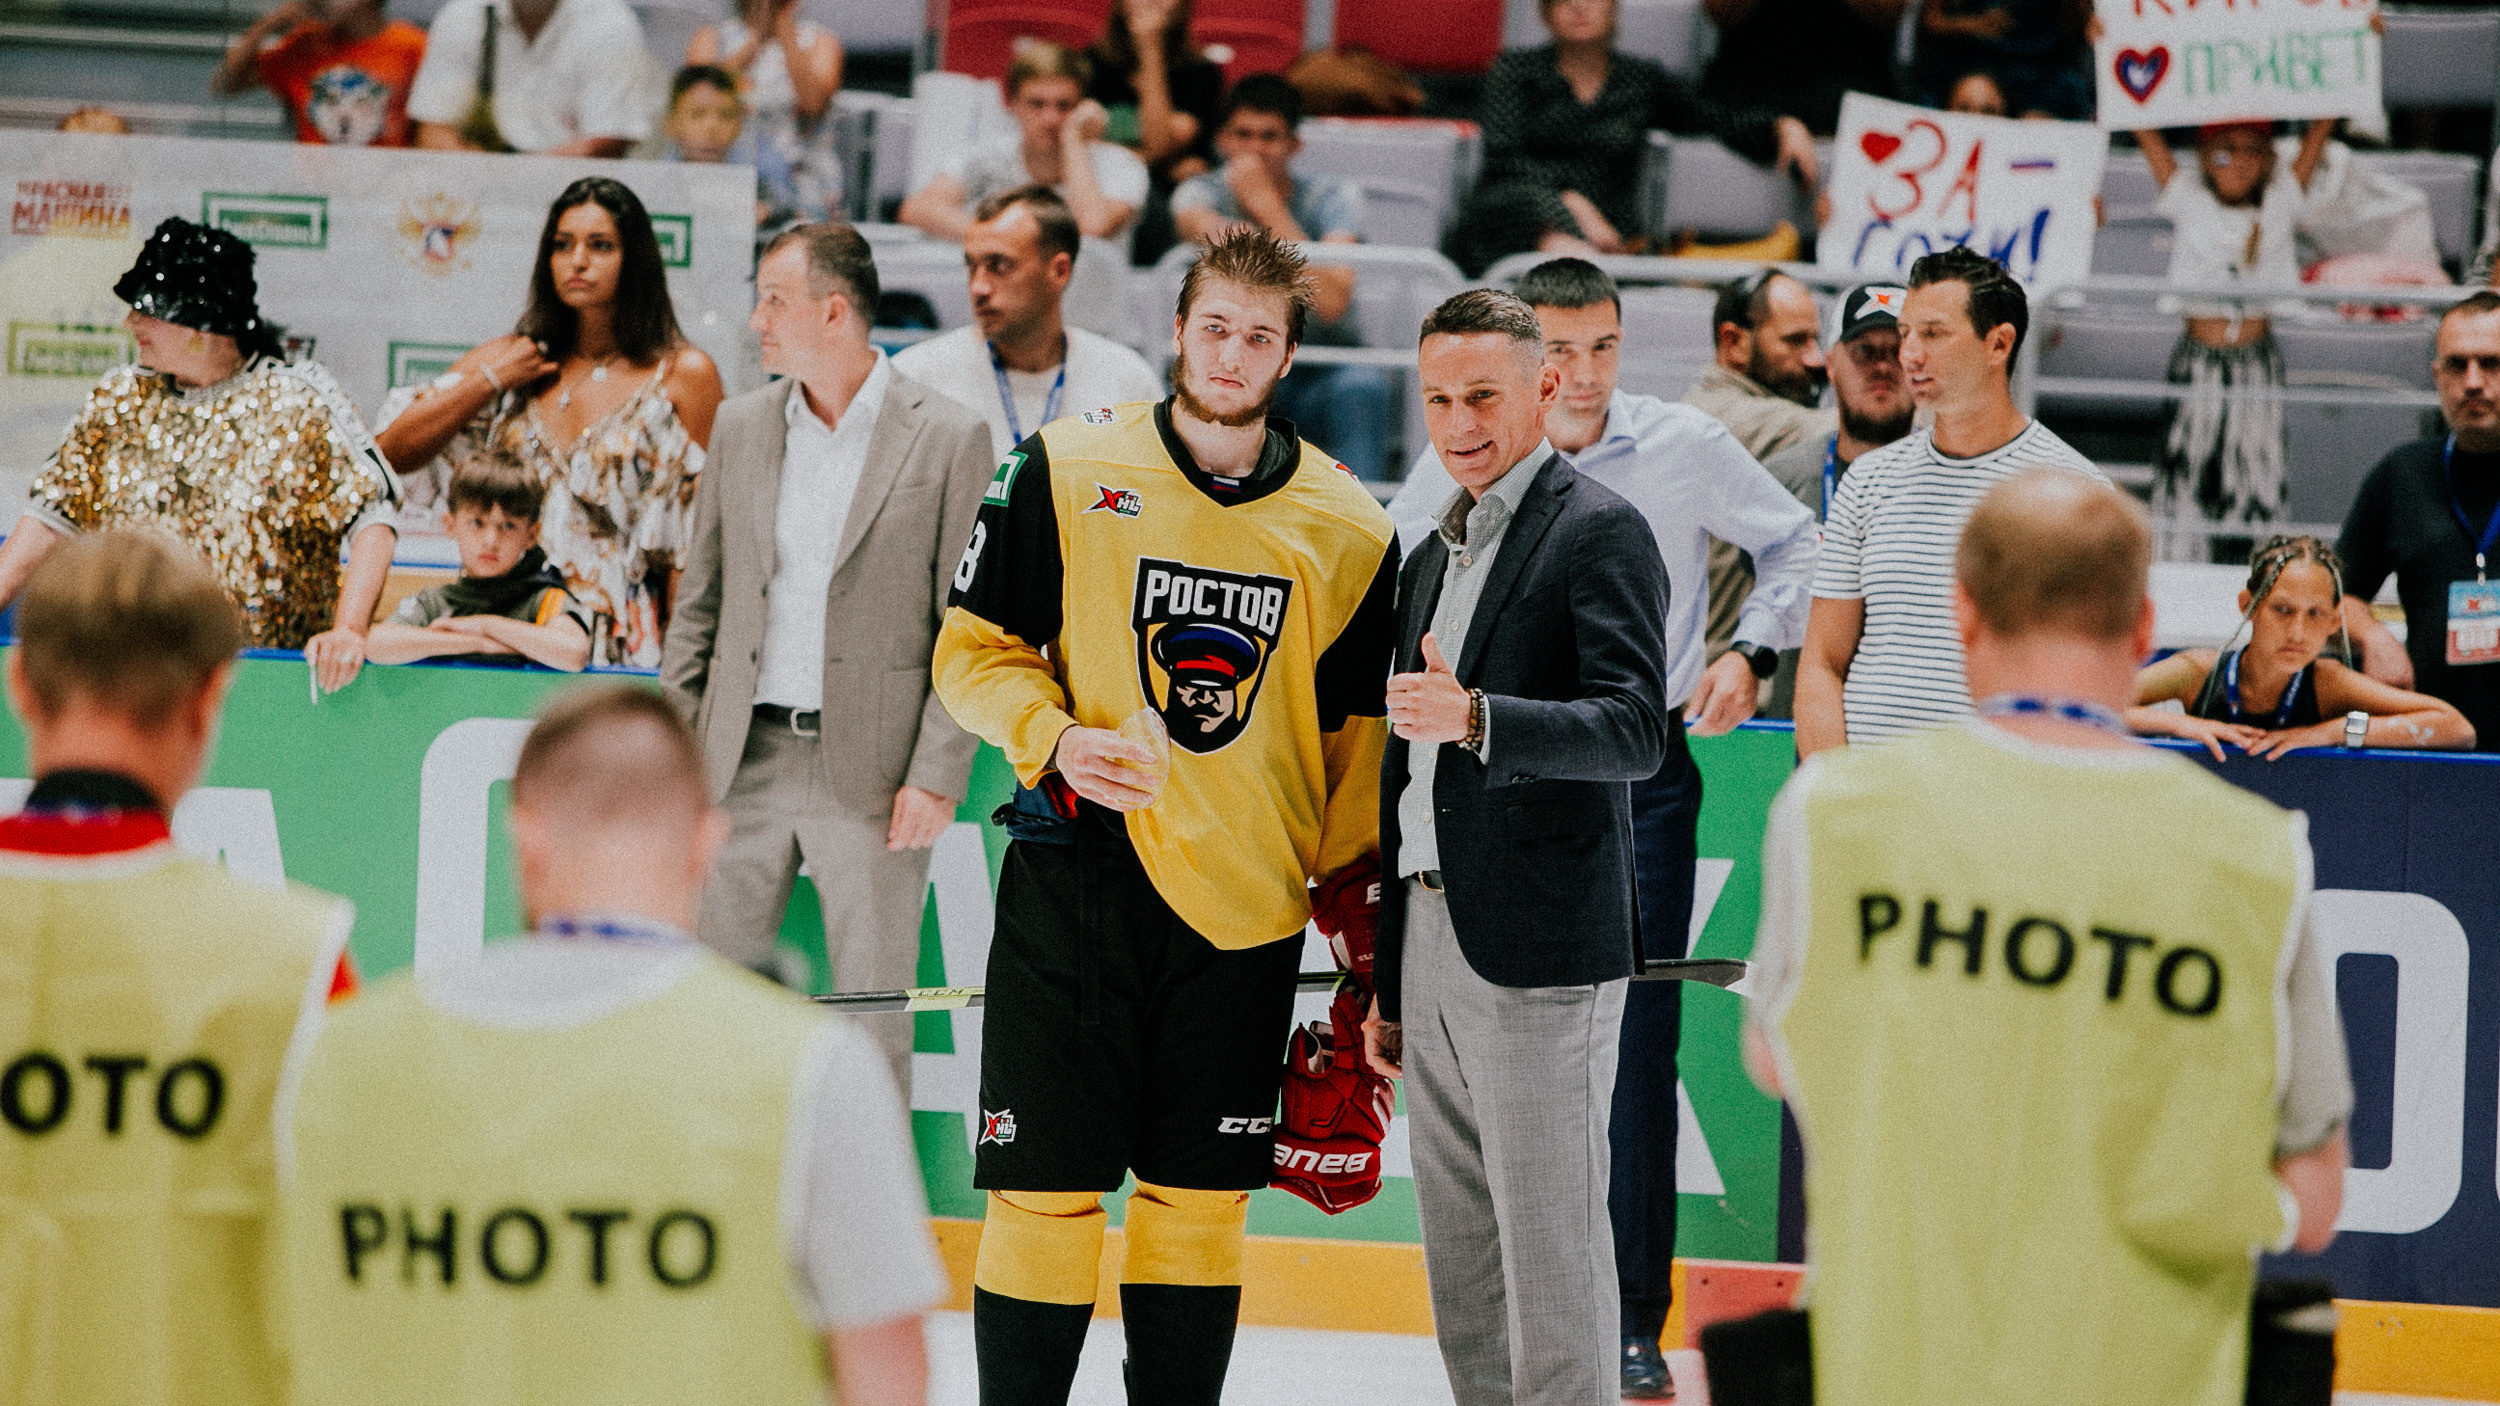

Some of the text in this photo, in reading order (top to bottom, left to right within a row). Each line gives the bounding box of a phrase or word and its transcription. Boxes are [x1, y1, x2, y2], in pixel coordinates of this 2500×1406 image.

[1142, 569, 1284, 637] РОСТОВ
[1857, 892, 2224, 1020] PHOTO
[0, 1050, 227, 1139] OTO
[1217, 1116, 1274, 1134] CC
[1273, 1143, 1374, 1174] BAUE
[339, 1203, 720, 1290] PHOTO
